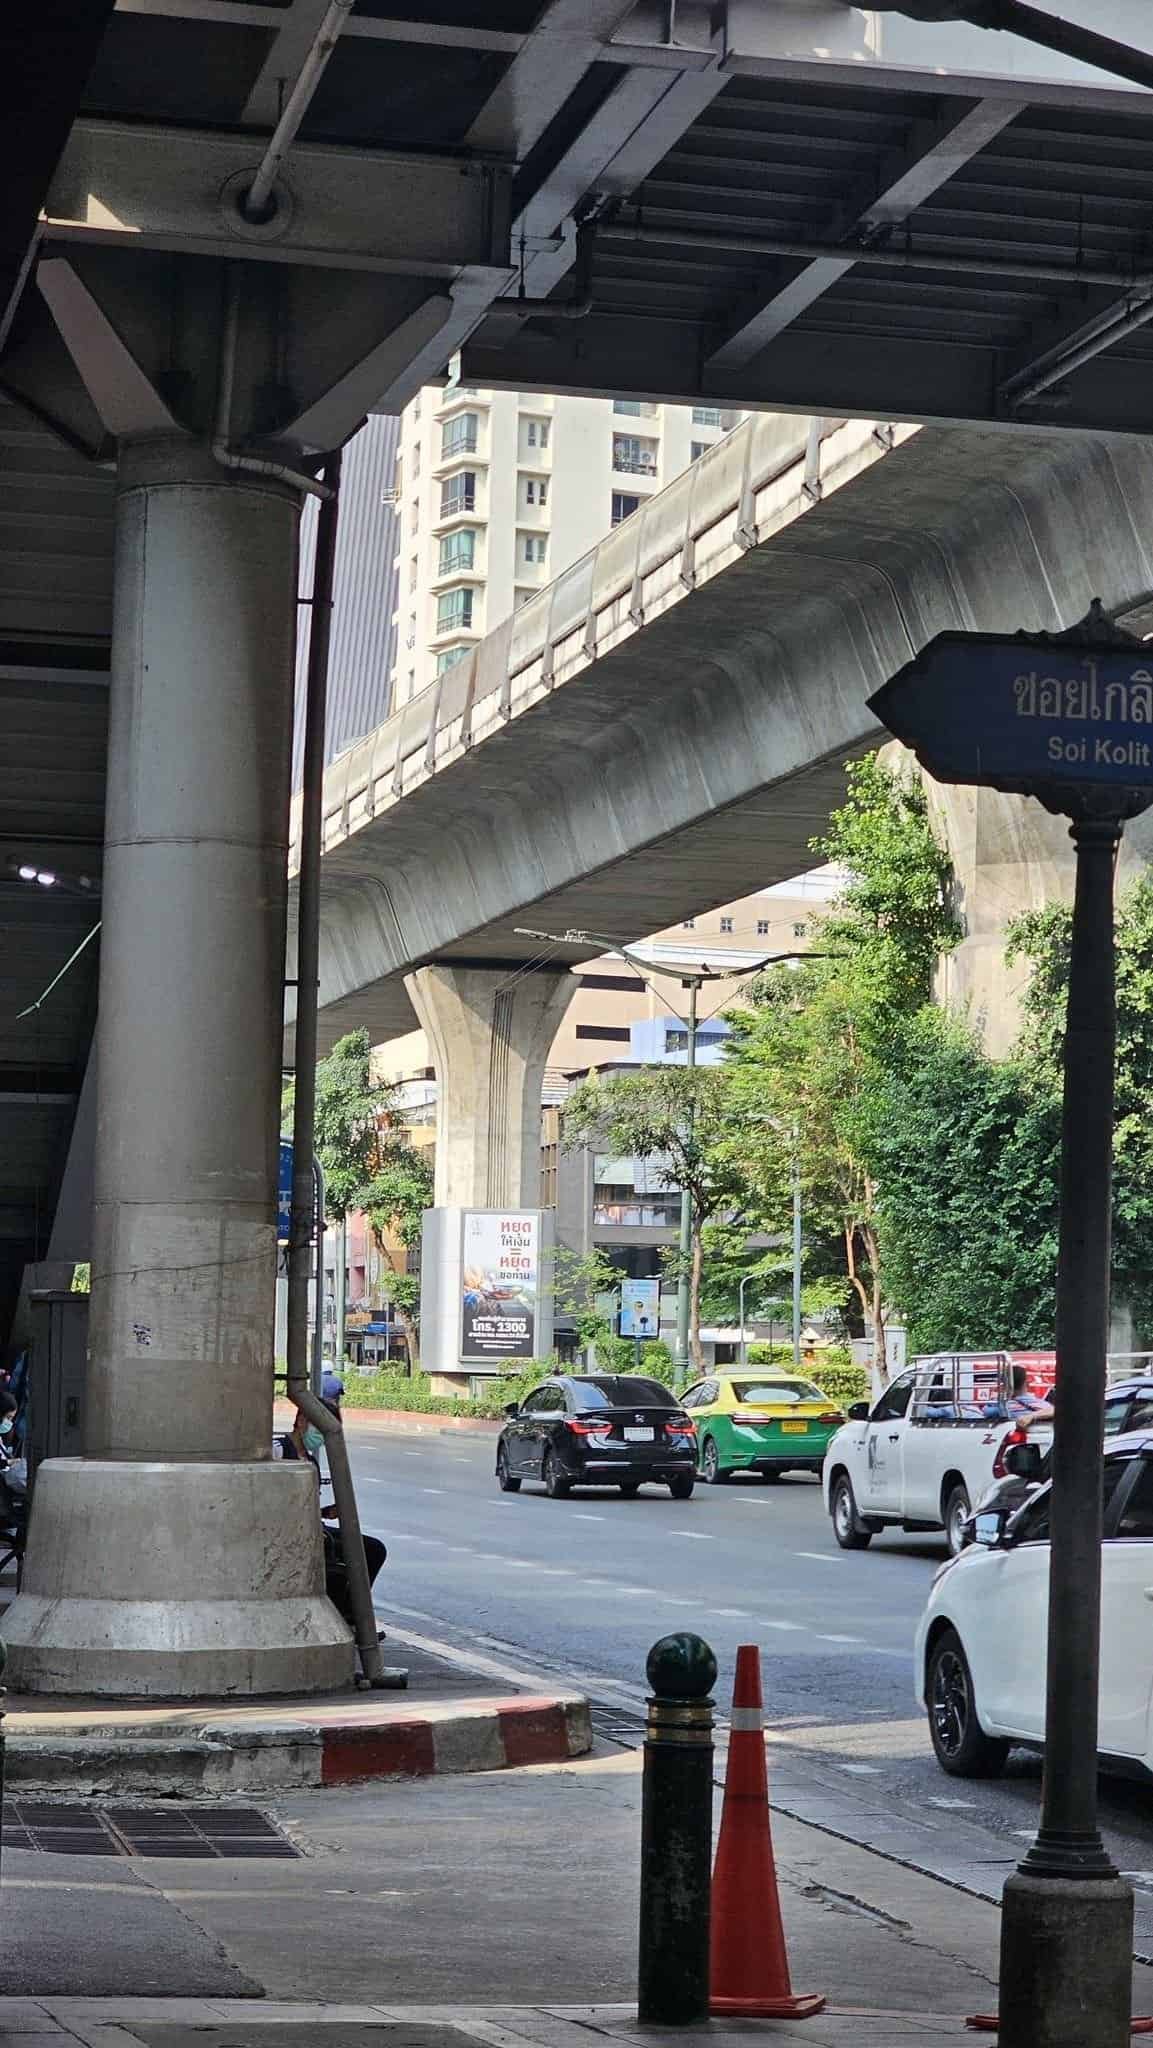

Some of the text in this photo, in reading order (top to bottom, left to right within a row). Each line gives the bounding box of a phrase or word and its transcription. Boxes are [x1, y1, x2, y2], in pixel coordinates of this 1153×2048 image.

[1048, 735, 1151, 766] Soi Kolit
[500, 1221, 532, 1235] หยุด
[499, 1256, 531, 1271] หยุด
